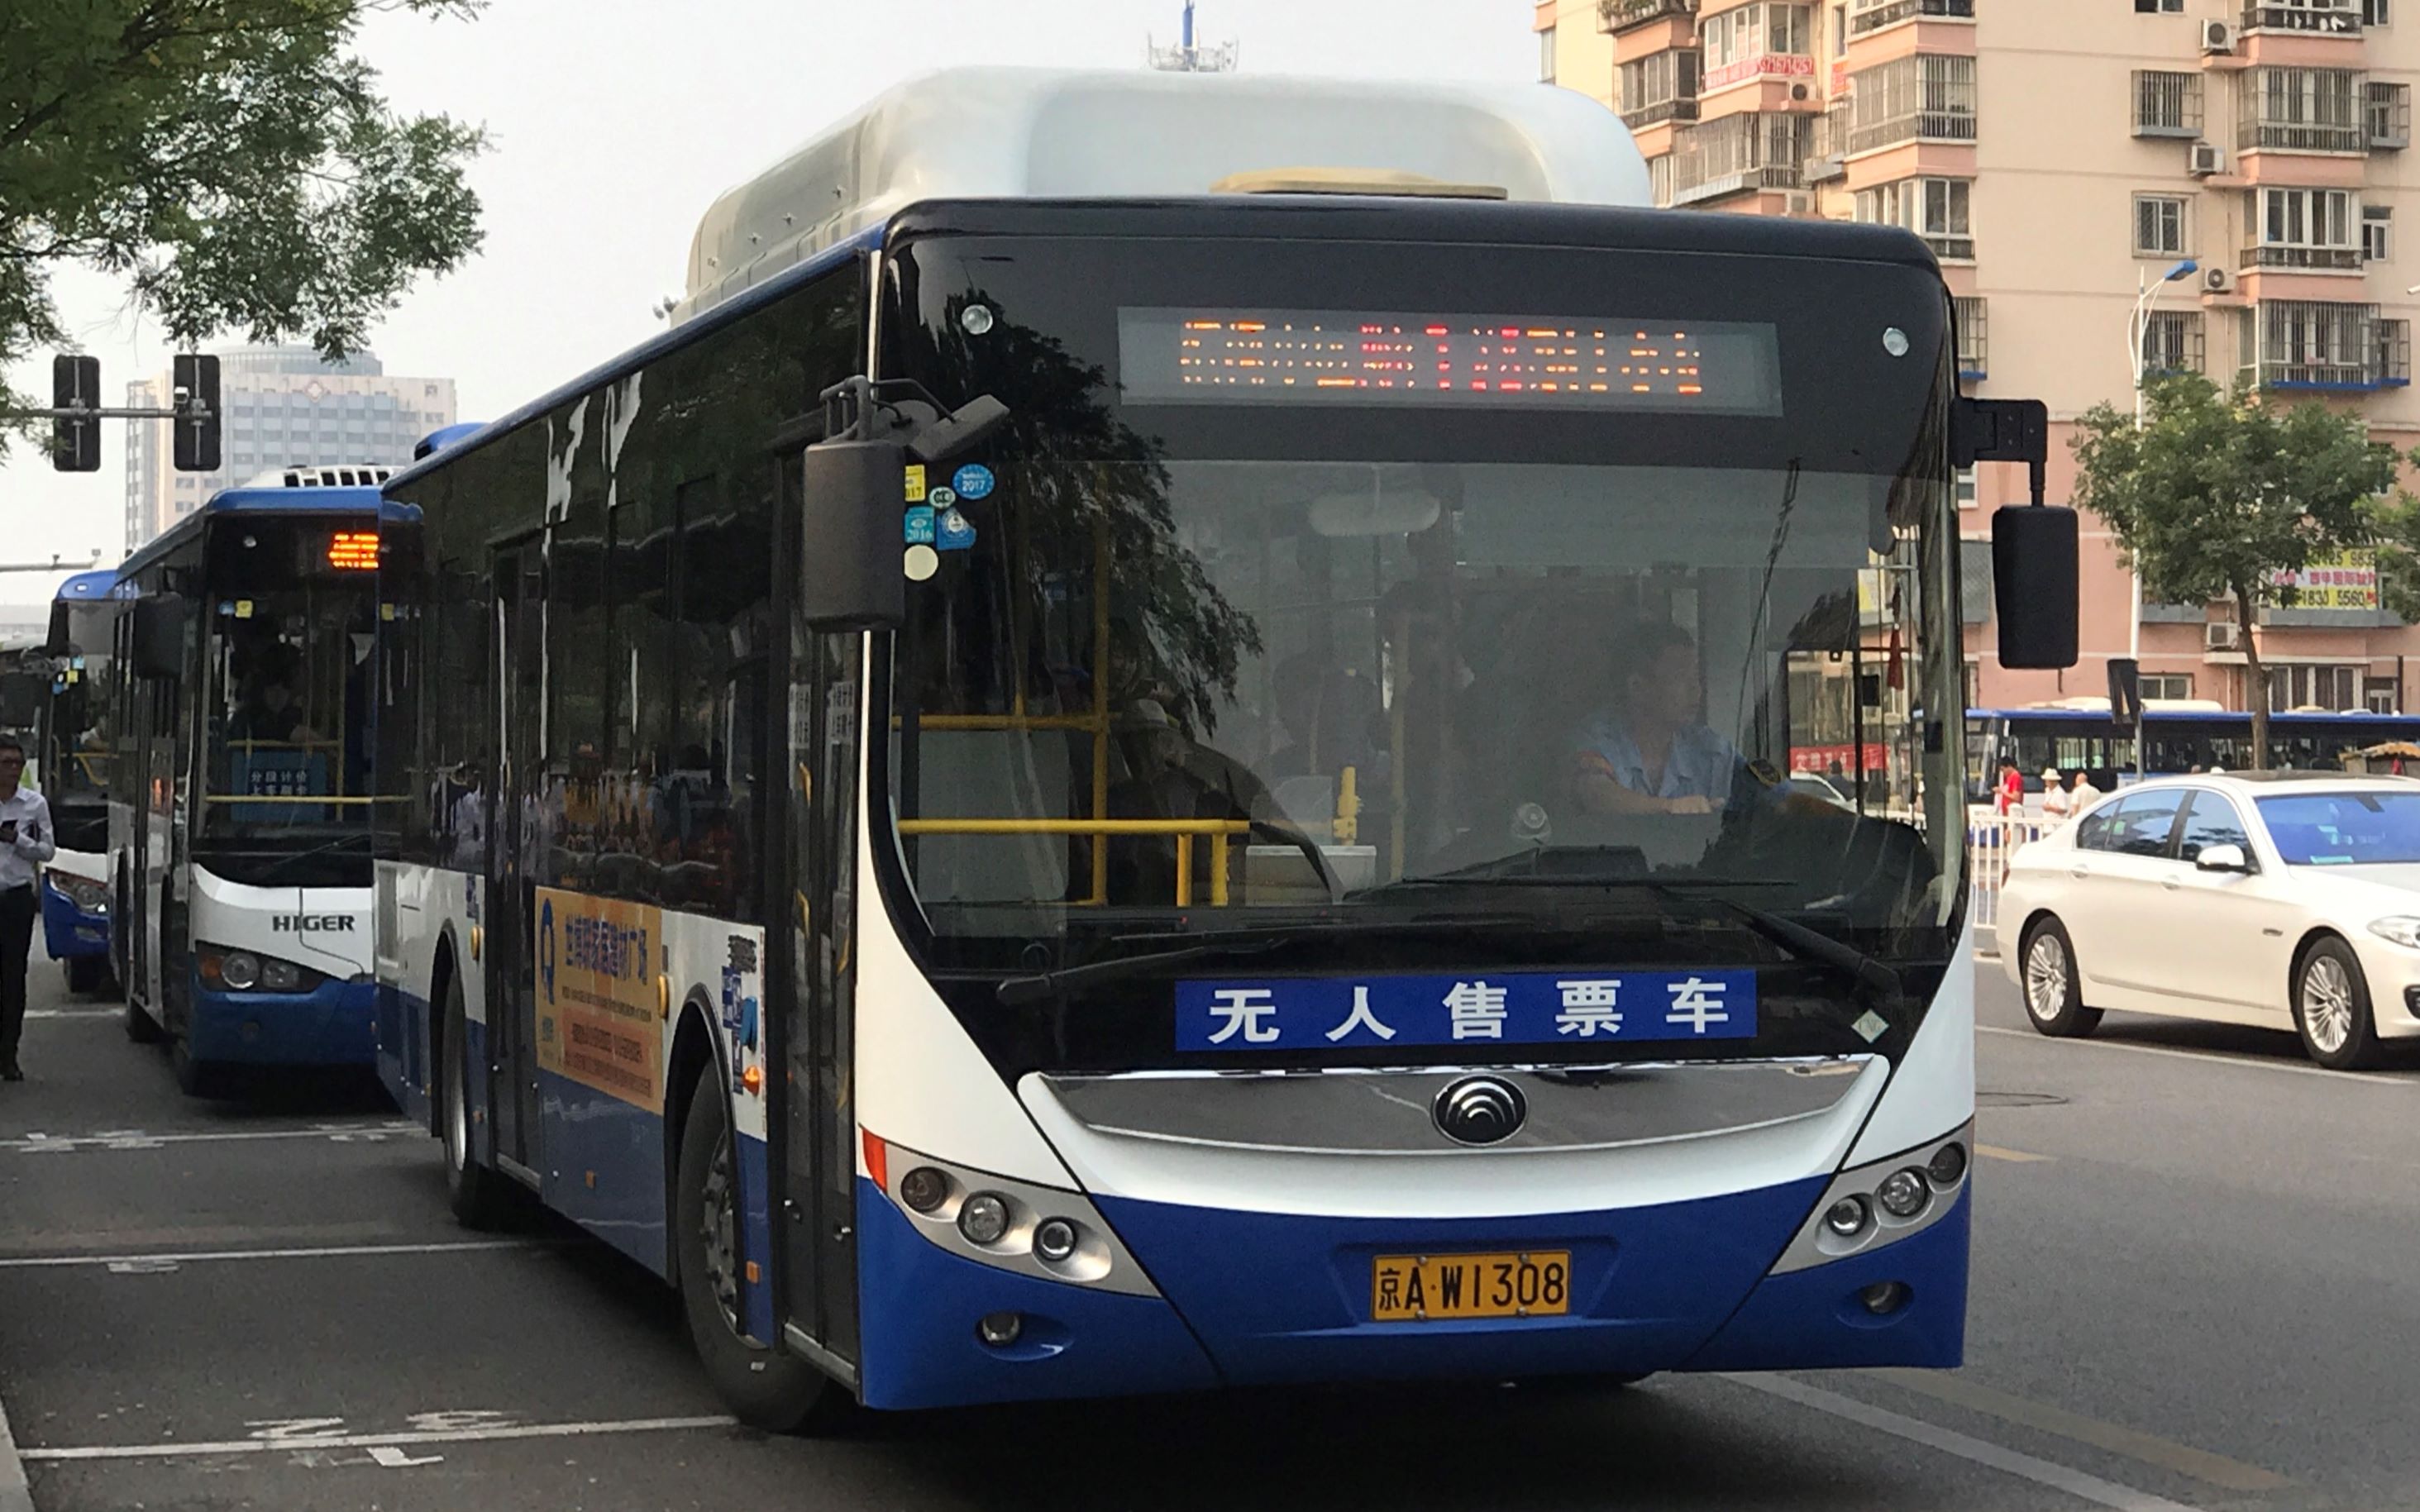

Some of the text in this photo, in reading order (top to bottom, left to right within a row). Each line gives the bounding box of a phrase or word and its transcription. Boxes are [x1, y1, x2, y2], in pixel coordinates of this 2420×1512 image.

[962, 480, 986, 493] 2017
[251, 770, 308, 783] 分段计价
[273, 915, 356, 932] HIGER
[1207, 976, 1730, 1044] 无人售票车
